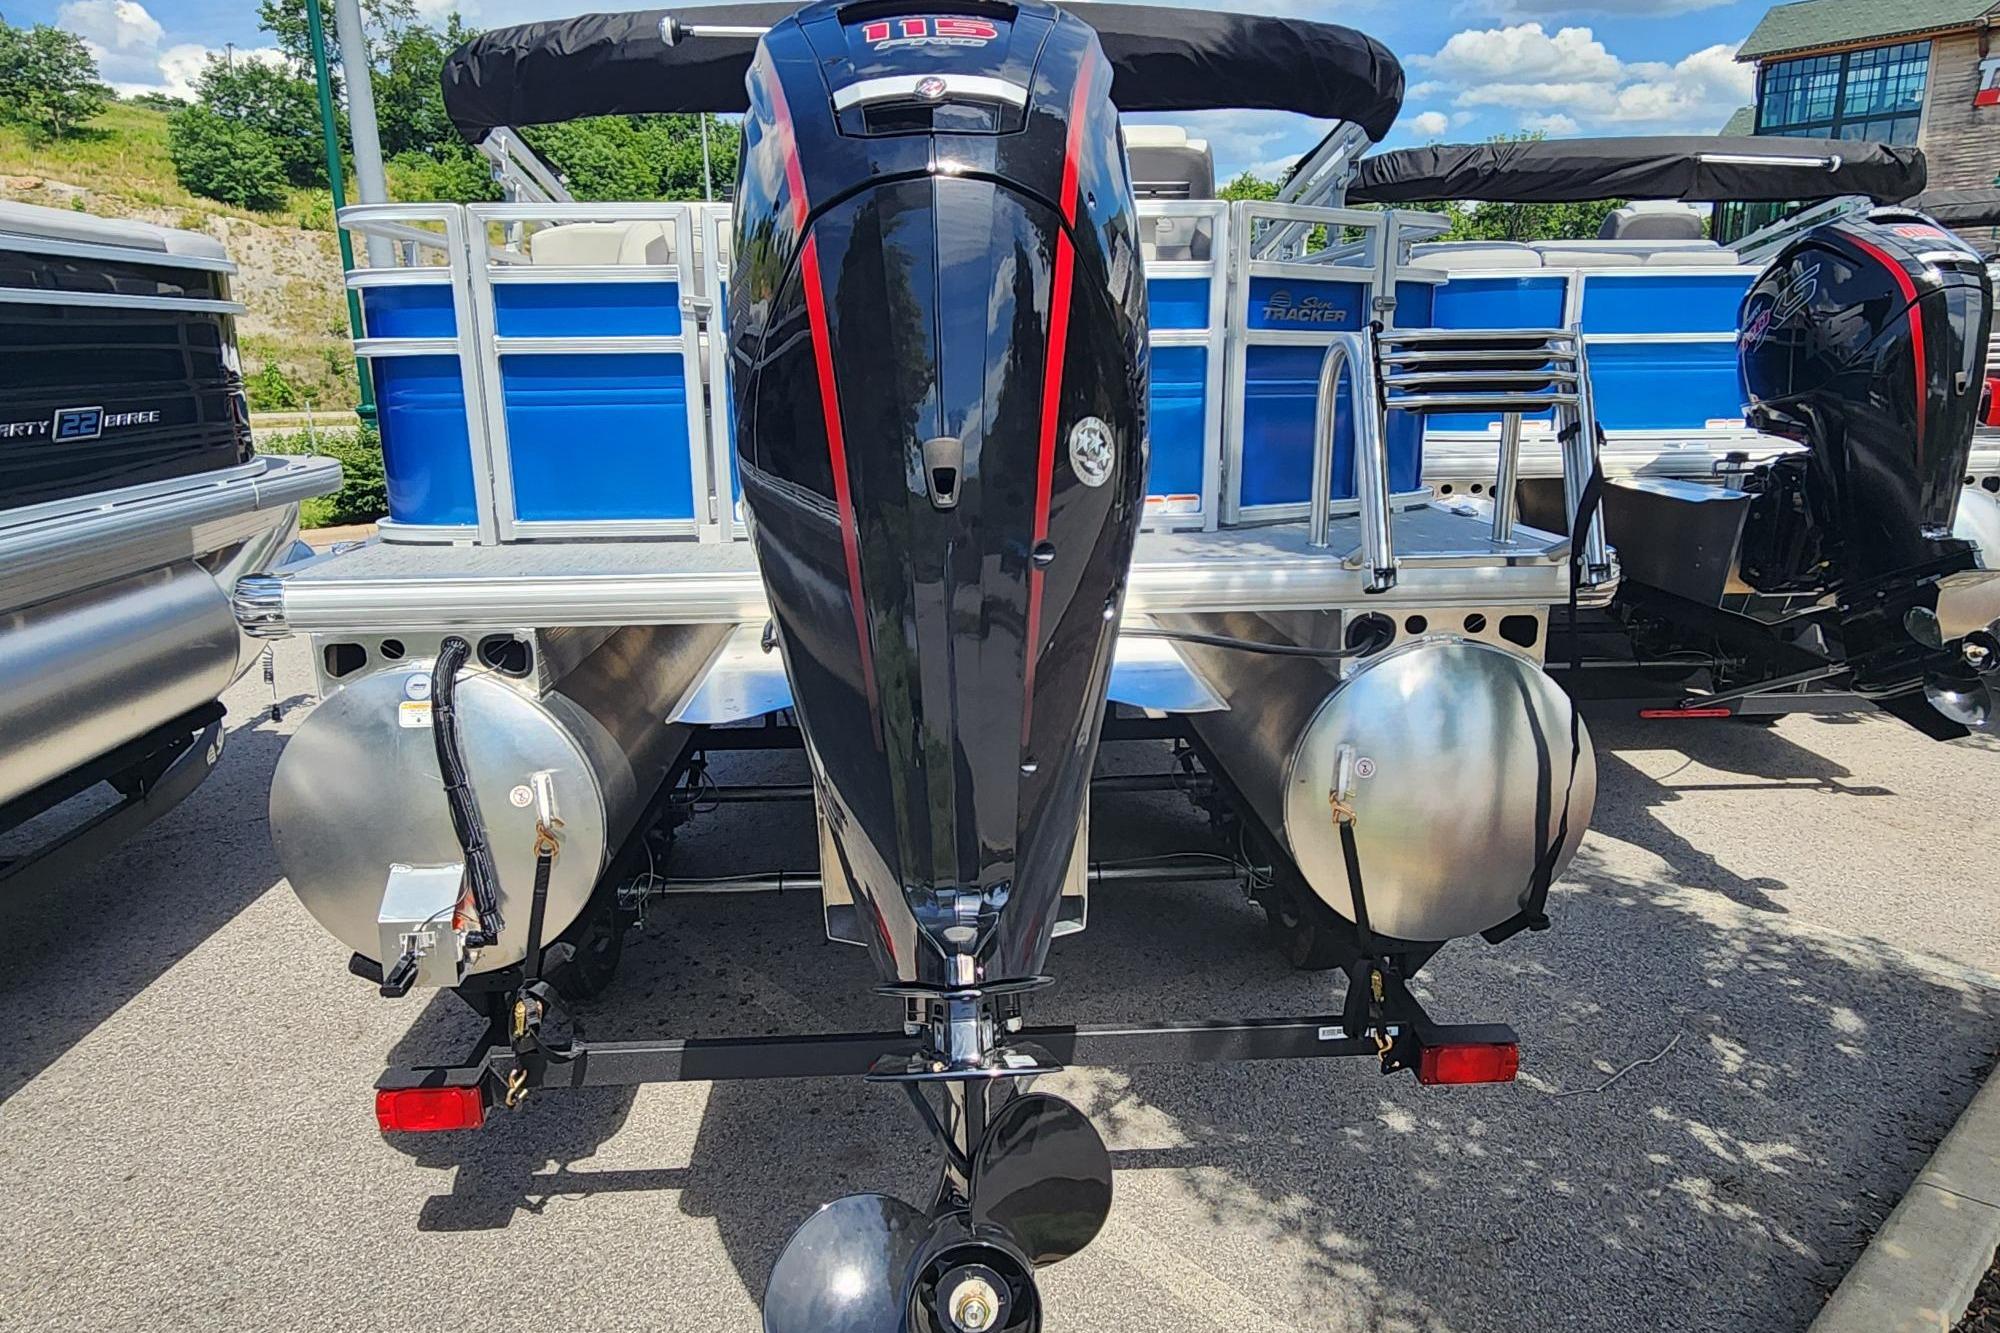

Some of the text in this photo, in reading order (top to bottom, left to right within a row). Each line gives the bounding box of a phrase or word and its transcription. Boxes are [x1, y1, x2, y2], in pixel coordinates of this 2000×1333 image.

[863, 18, 998, 42] 115
[1299, 296, 1334, 310] Sun
[1263, 307, 1347, 322] TRACKER
[61, 412, 98, 436] 22
[104, 410, 160, 427] BARGE
